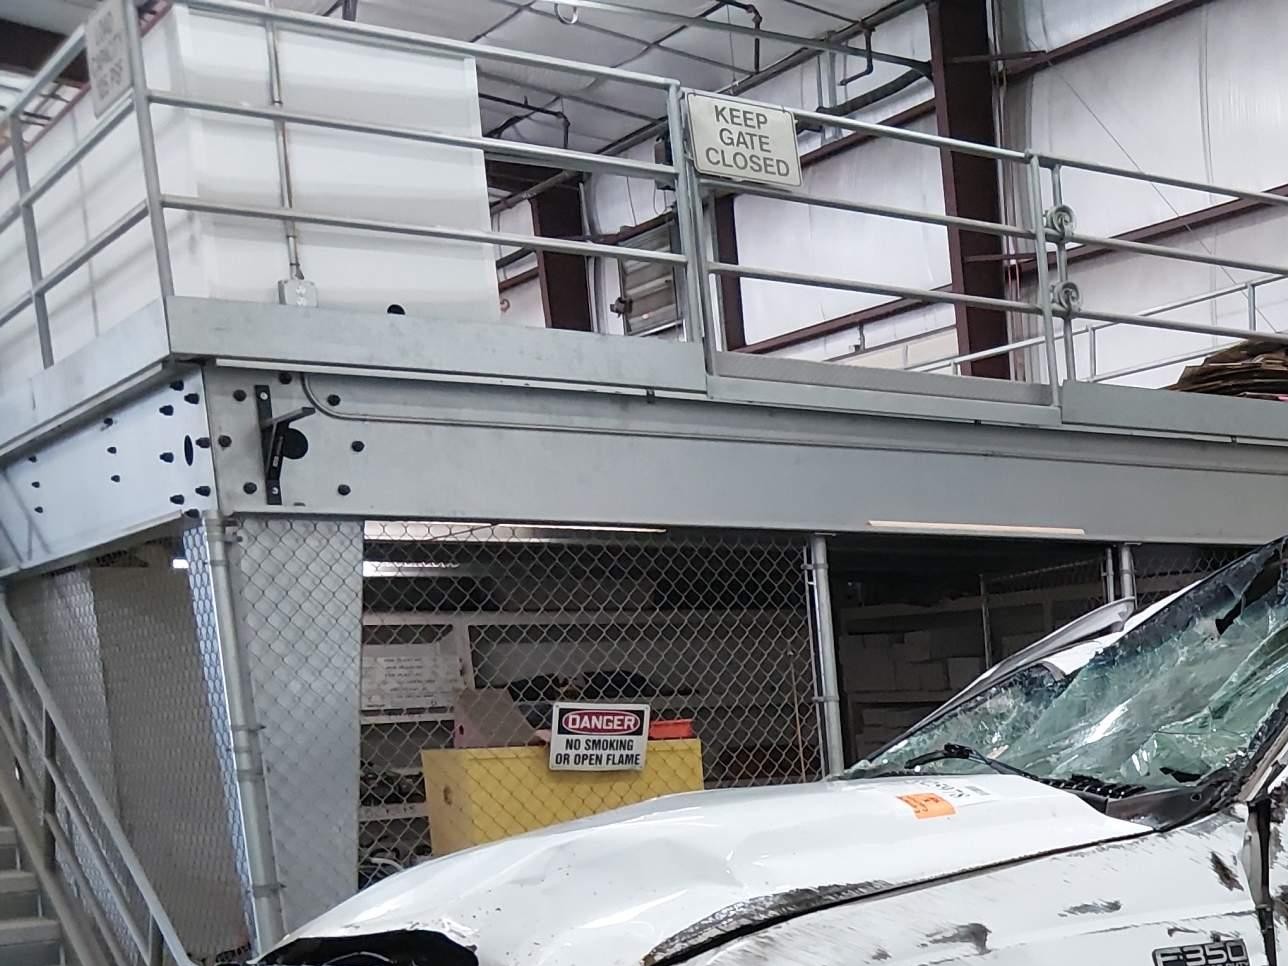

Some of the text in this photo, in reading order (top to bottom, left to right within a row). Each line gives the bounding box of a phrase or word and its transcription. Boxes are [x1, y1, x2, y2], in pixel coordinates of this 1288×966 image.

[714, 105, 768, 130] KEEP
[719, 128, 772, 153] GATE
[705, 147, 790, 177] CLOSED
[568, 715, 636, 730] DANGER
[565, 738, 634, 751] NO SMOKING
[555, 753, 641, 766] OR OPEN FLAME
